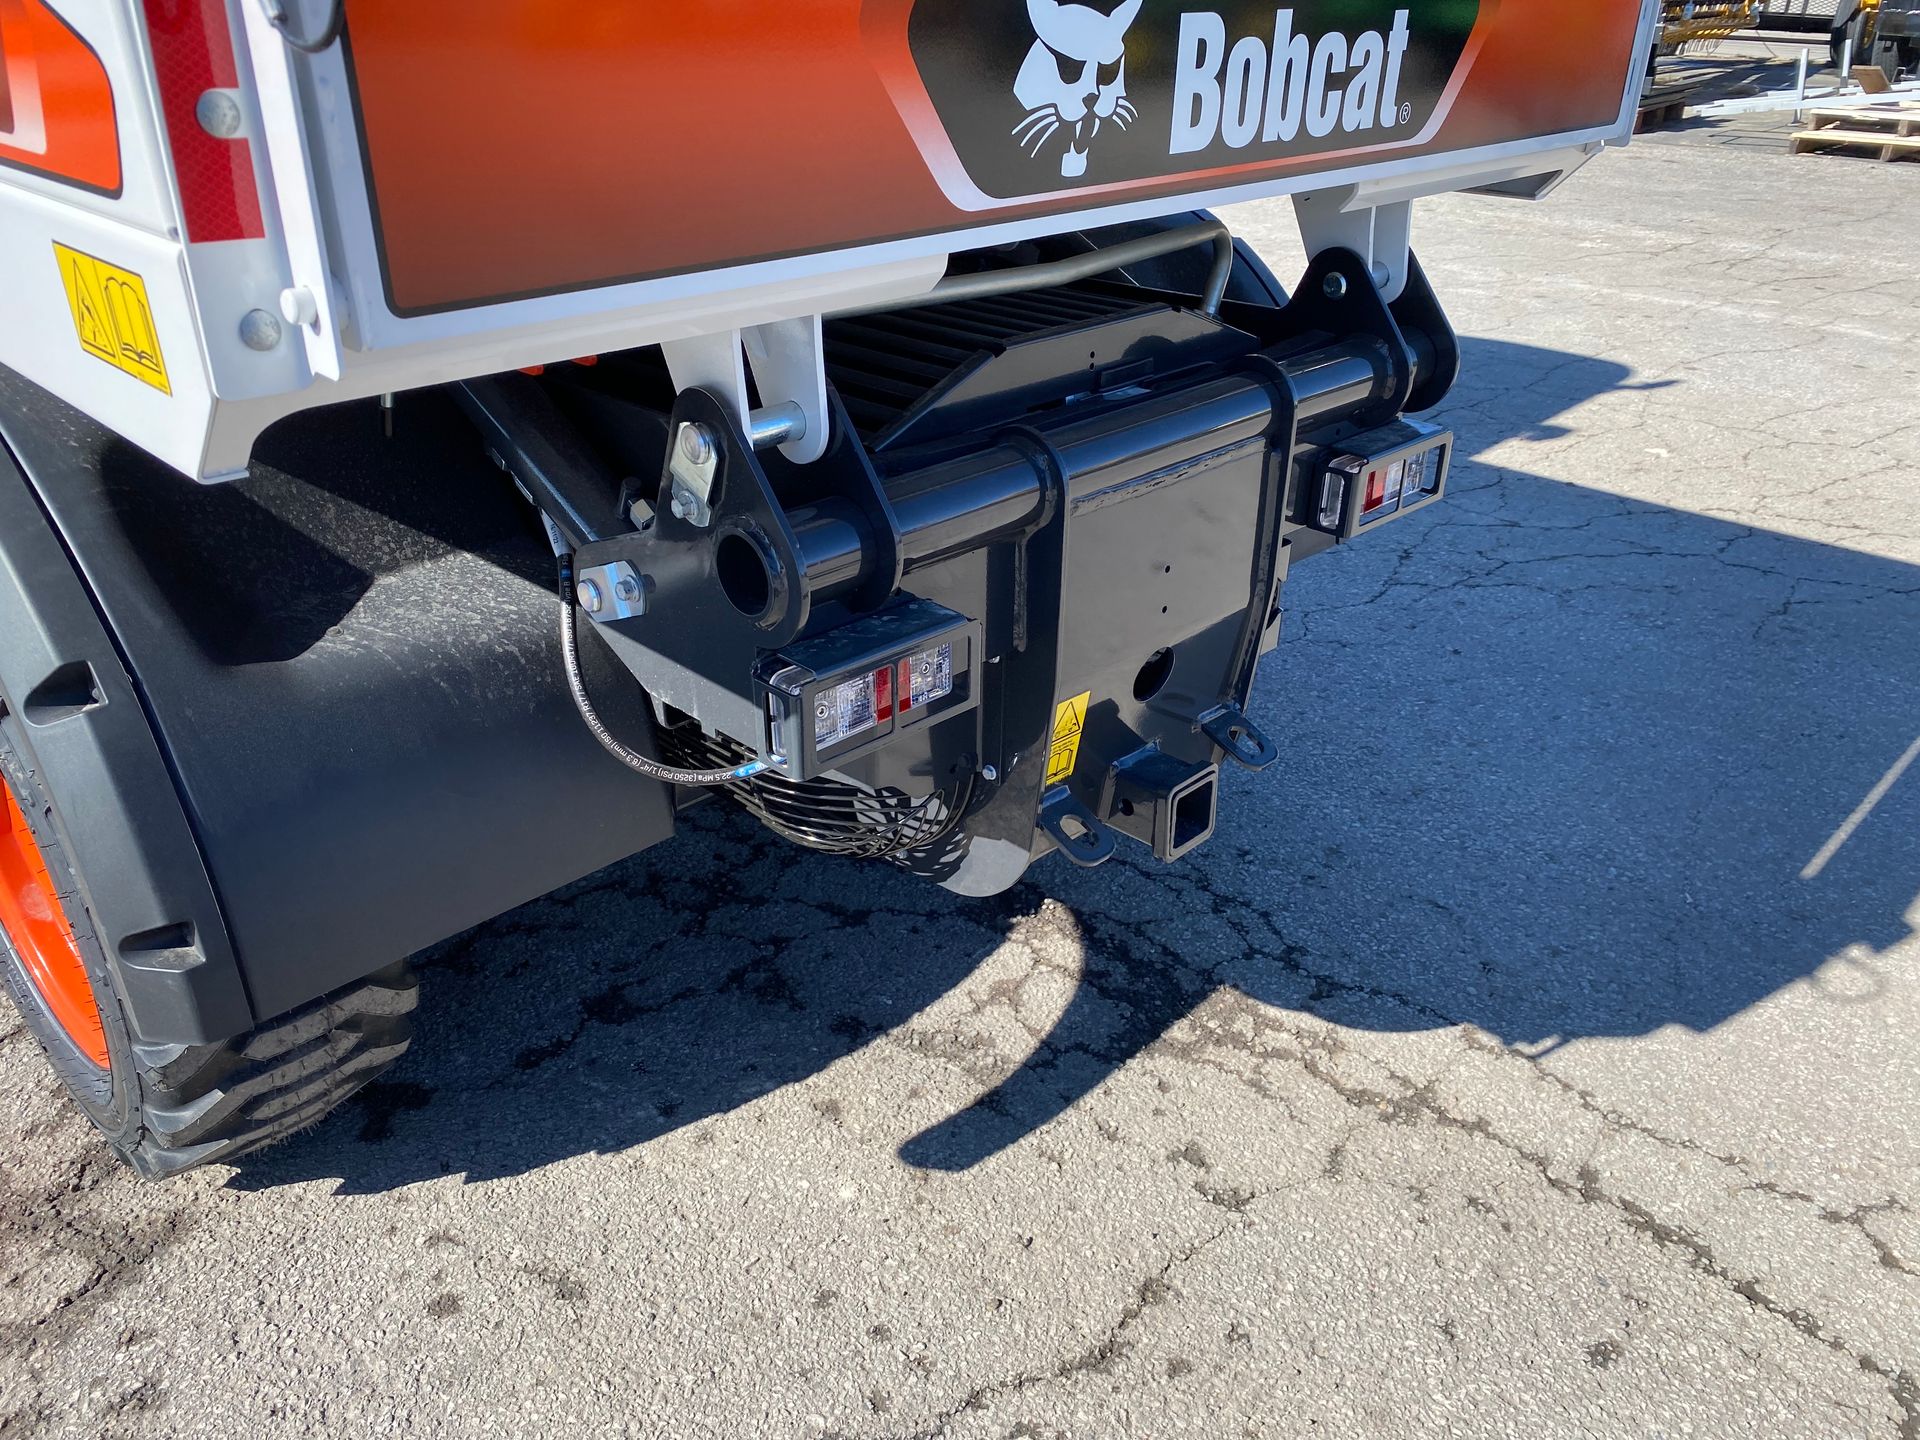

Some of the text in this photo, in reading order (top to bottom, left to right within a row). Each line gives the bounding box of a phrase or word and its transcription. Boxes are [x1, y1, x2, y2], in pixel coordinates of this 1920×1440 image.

[579, 696, 591, 711] R17
[586, 711, 604, 734] 11237
[601, 732, 613, 745] ISO
[698, 773, 714, 782] MPa
[714, 771, 732, 781] 22.5
